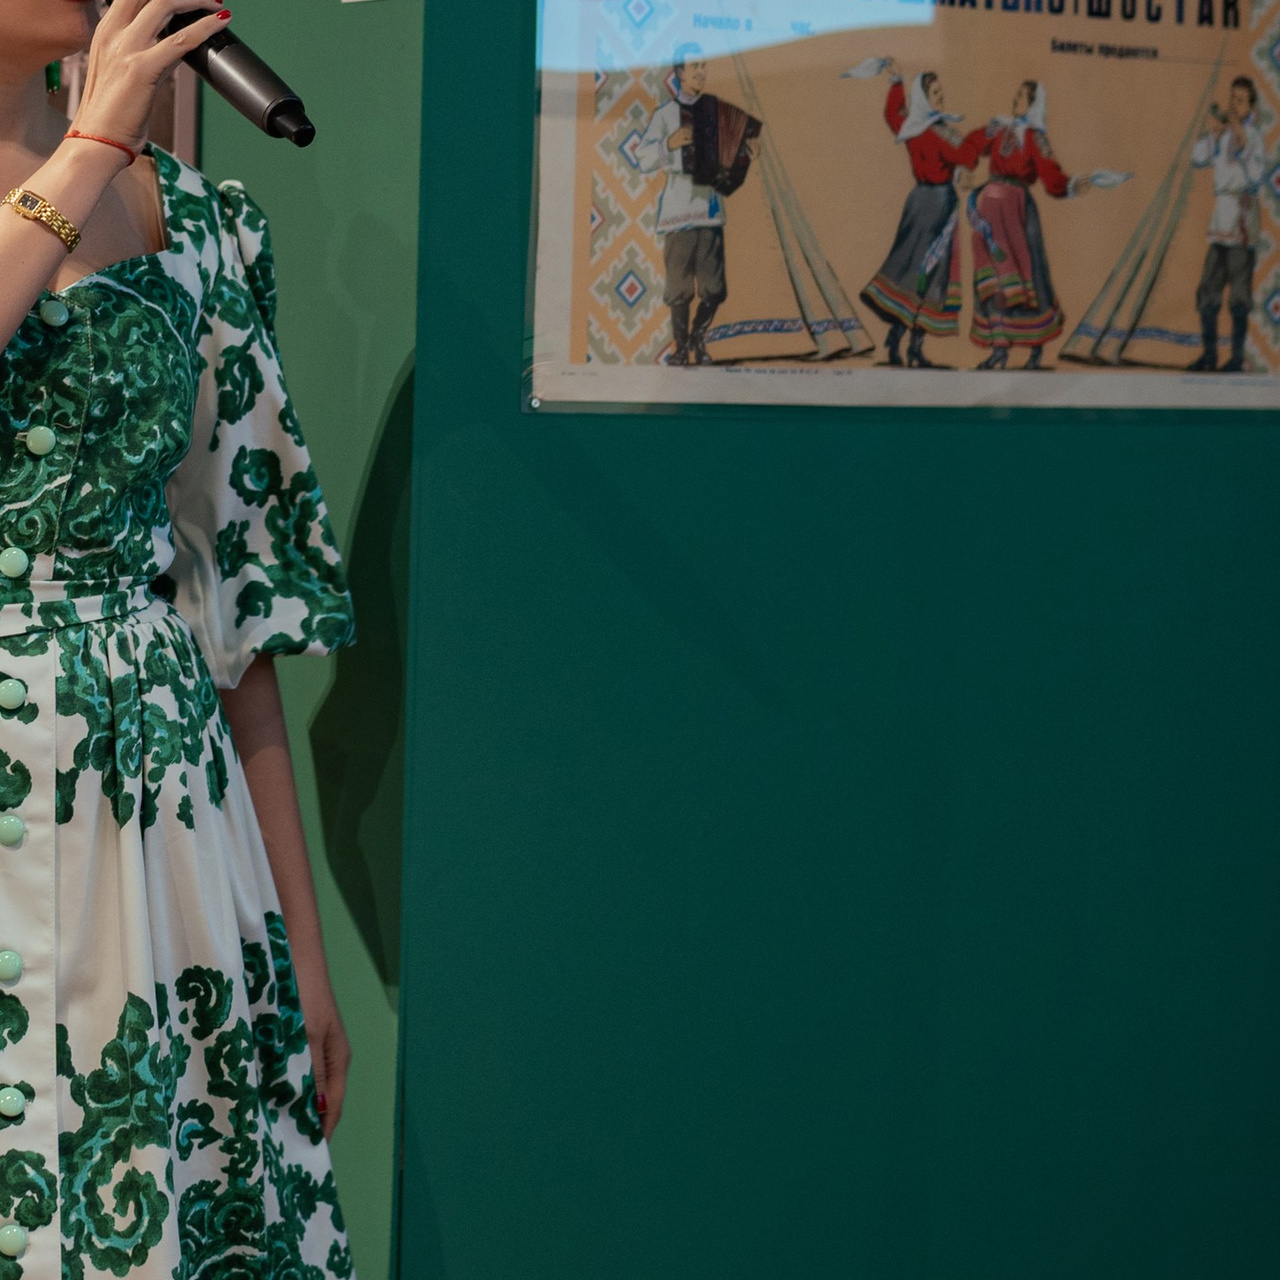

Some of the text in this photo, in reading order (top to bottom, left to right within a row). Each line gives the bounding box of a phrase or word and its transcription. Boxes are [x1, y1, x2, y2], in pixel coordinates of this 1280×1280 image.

[692, 11, 742, 31] Начало
[1050, 36, 1159, 60] Билеты продаются
